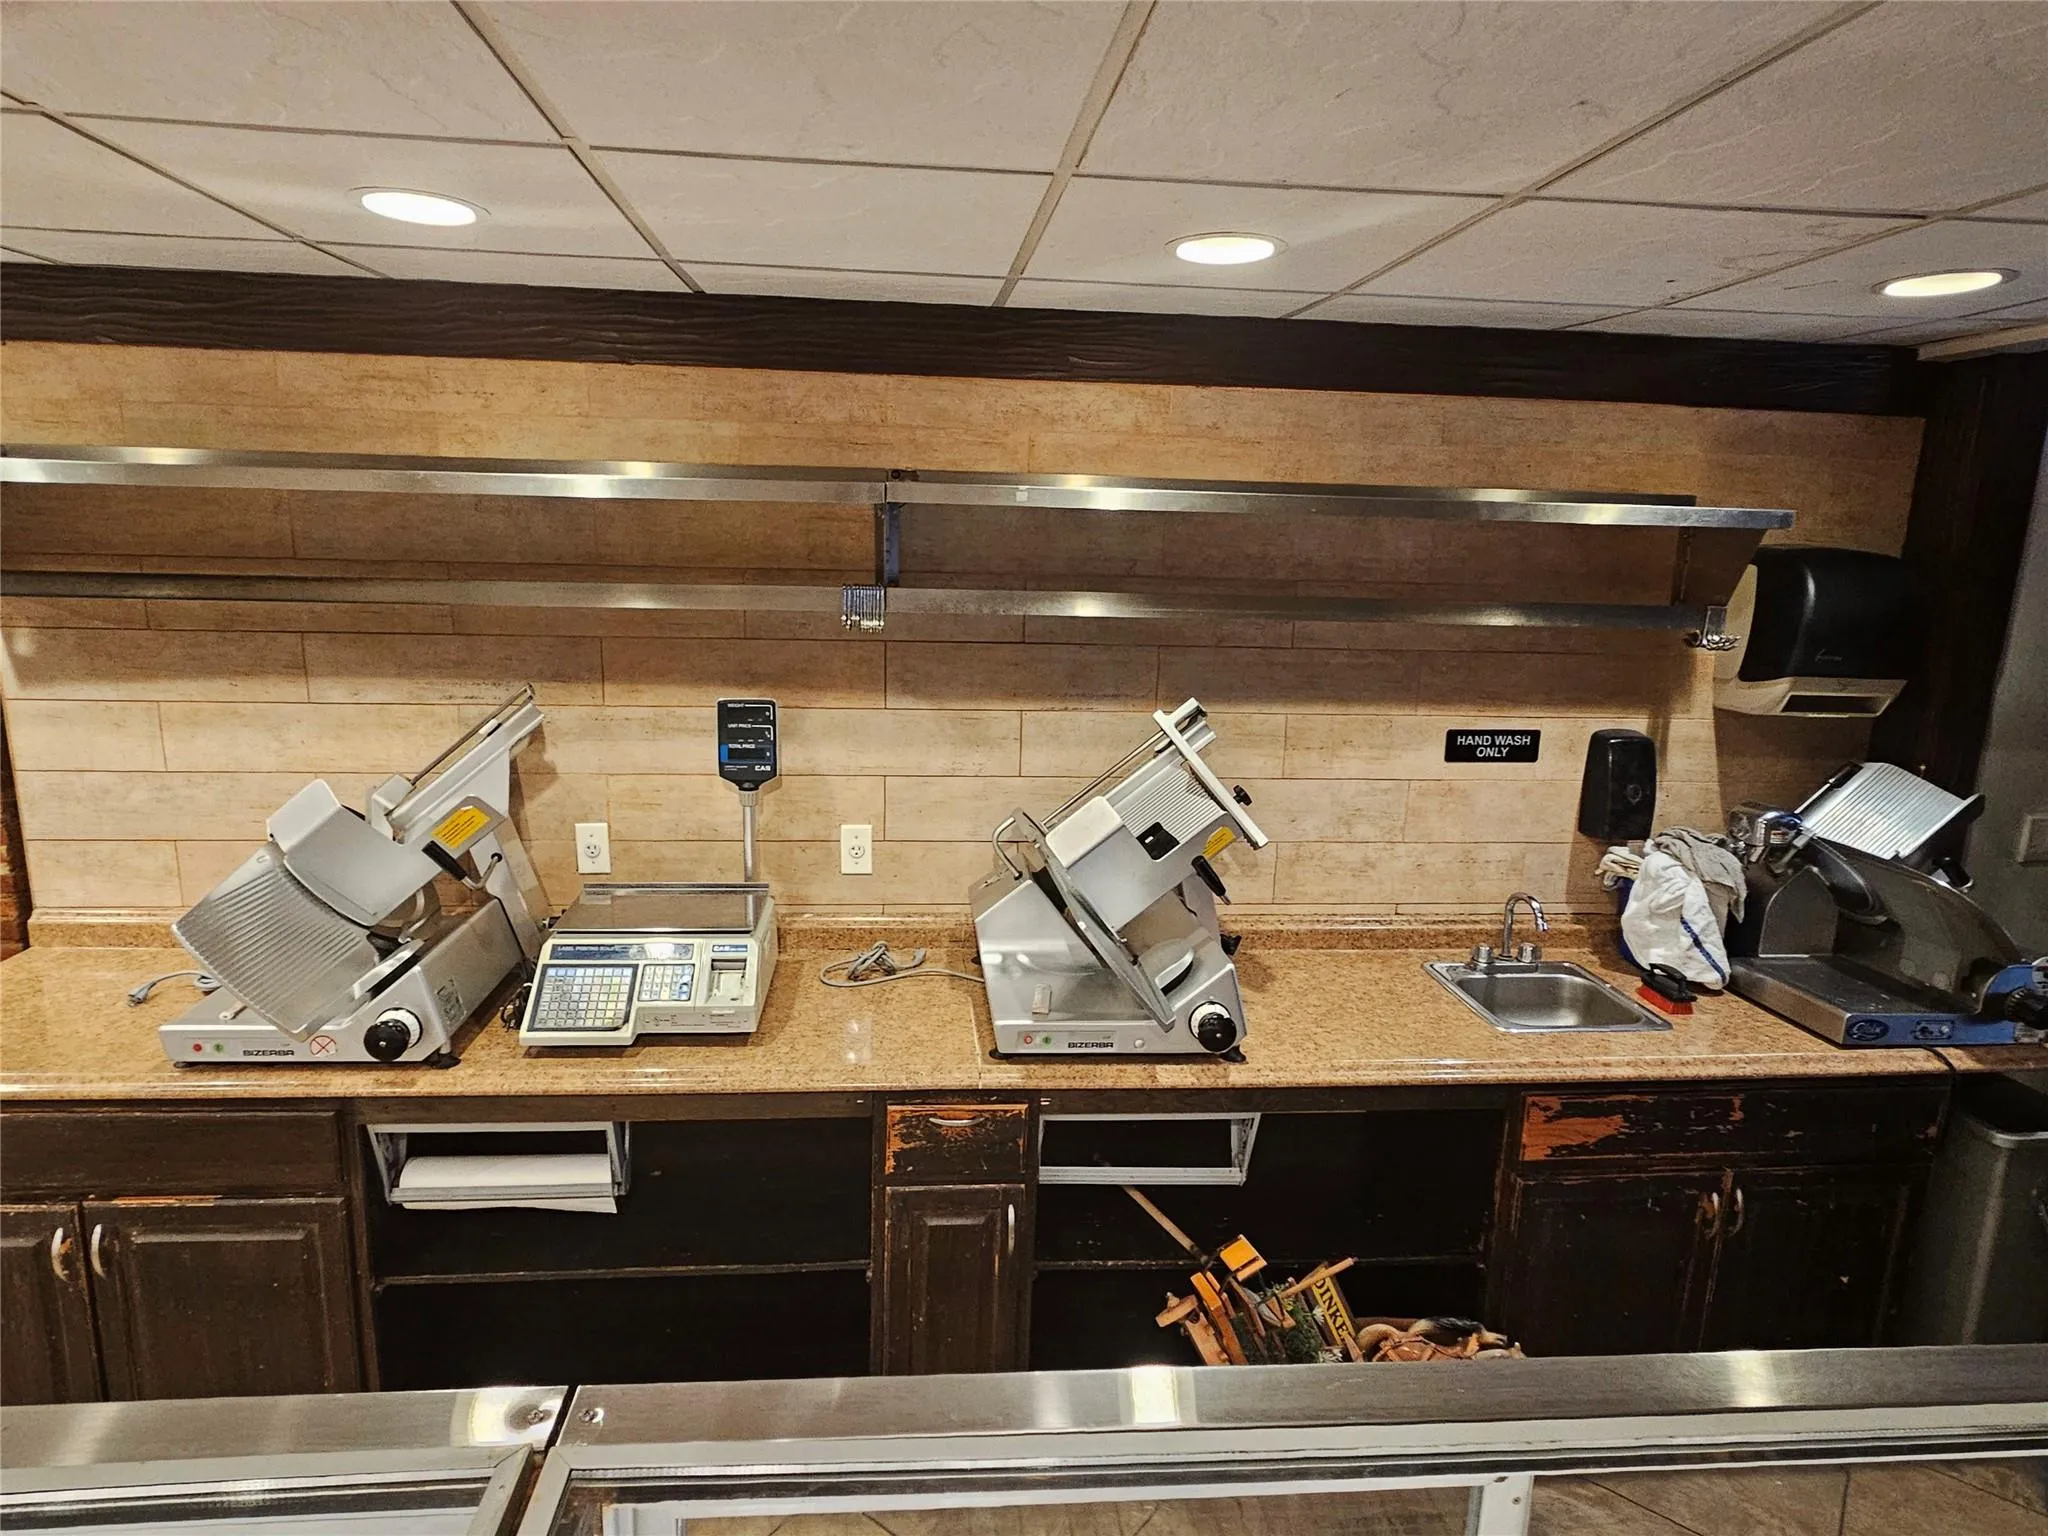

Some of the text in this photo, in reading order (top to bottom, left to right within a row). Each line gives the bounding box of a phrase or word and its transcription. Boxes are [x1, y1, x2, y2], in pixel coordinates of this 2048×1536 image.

[1457, 735, 1531, 746] HAND WASH
[1476, 747, 1510, 757] ONLY
[1067, 1041, 1114, 1049] BIZERBA
[242, 1049, 295, 1057] BIZERBA
